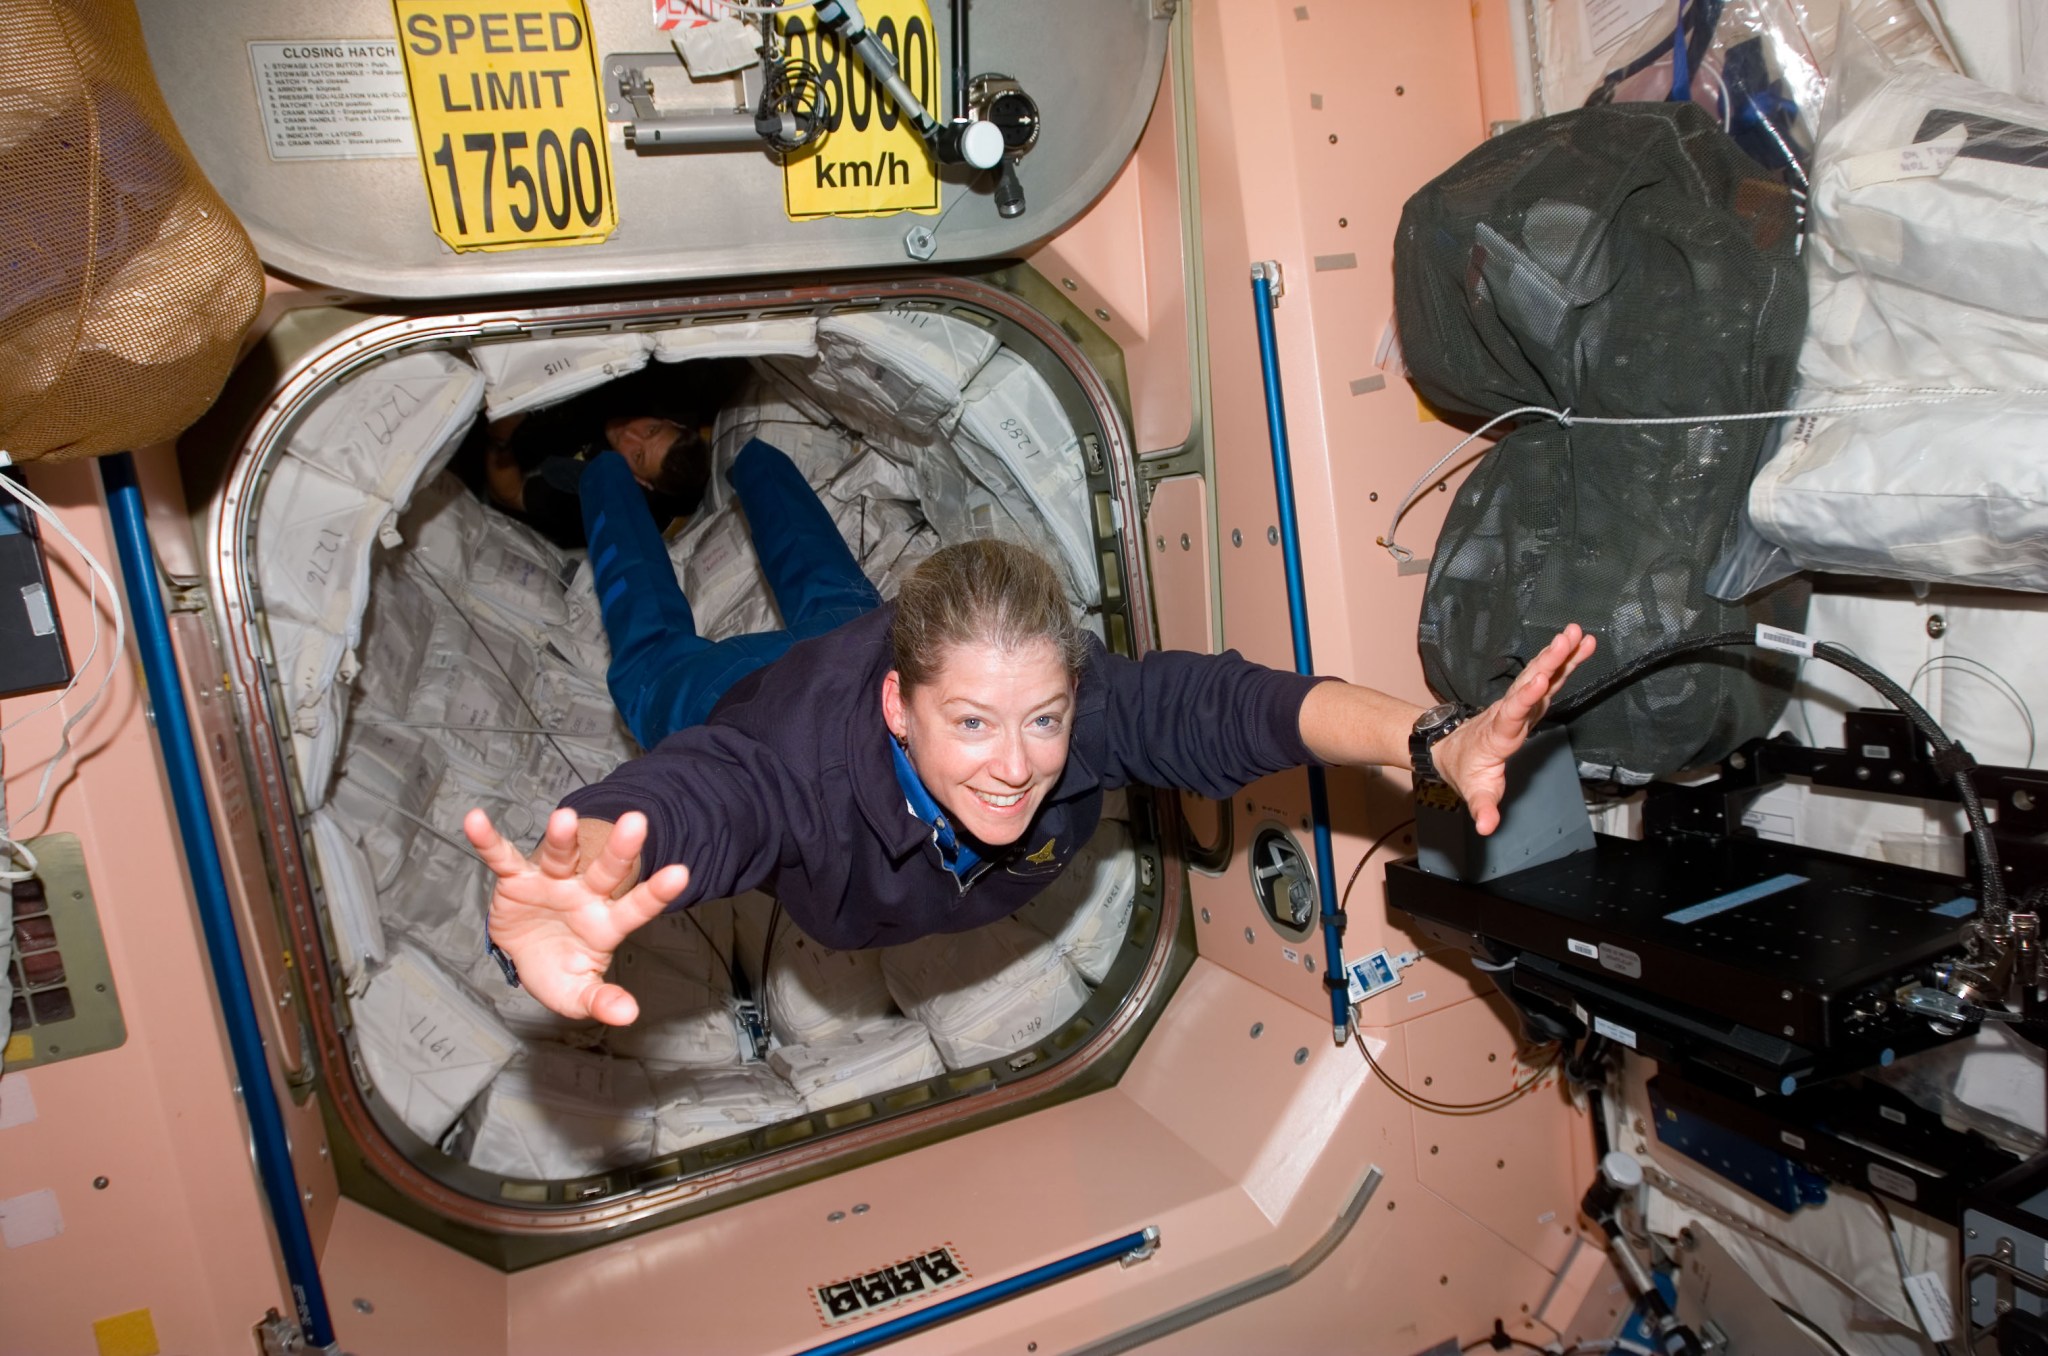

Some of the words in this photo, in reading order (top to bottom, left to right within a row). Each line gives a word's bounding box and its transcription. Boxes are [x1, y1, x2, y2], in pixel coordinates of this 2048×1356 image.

[283, 47, 344, 59] CLOSING
[349, 46, 395, 58] HATCH
[407, 12, 582, 56] SPEED
[439, 70, 570, 112] LIMIT
[434, 127, 603, 235] 17500
[815, 151, 910, 189] km/h
[544, 357, 571, 376] 1113
[364, 384, 421, 445] 1279
[1000, 418, 1041, 459] 1288
[306, 529, 343, 586] 1276
[409, 1016, 457, 1063] 1161
